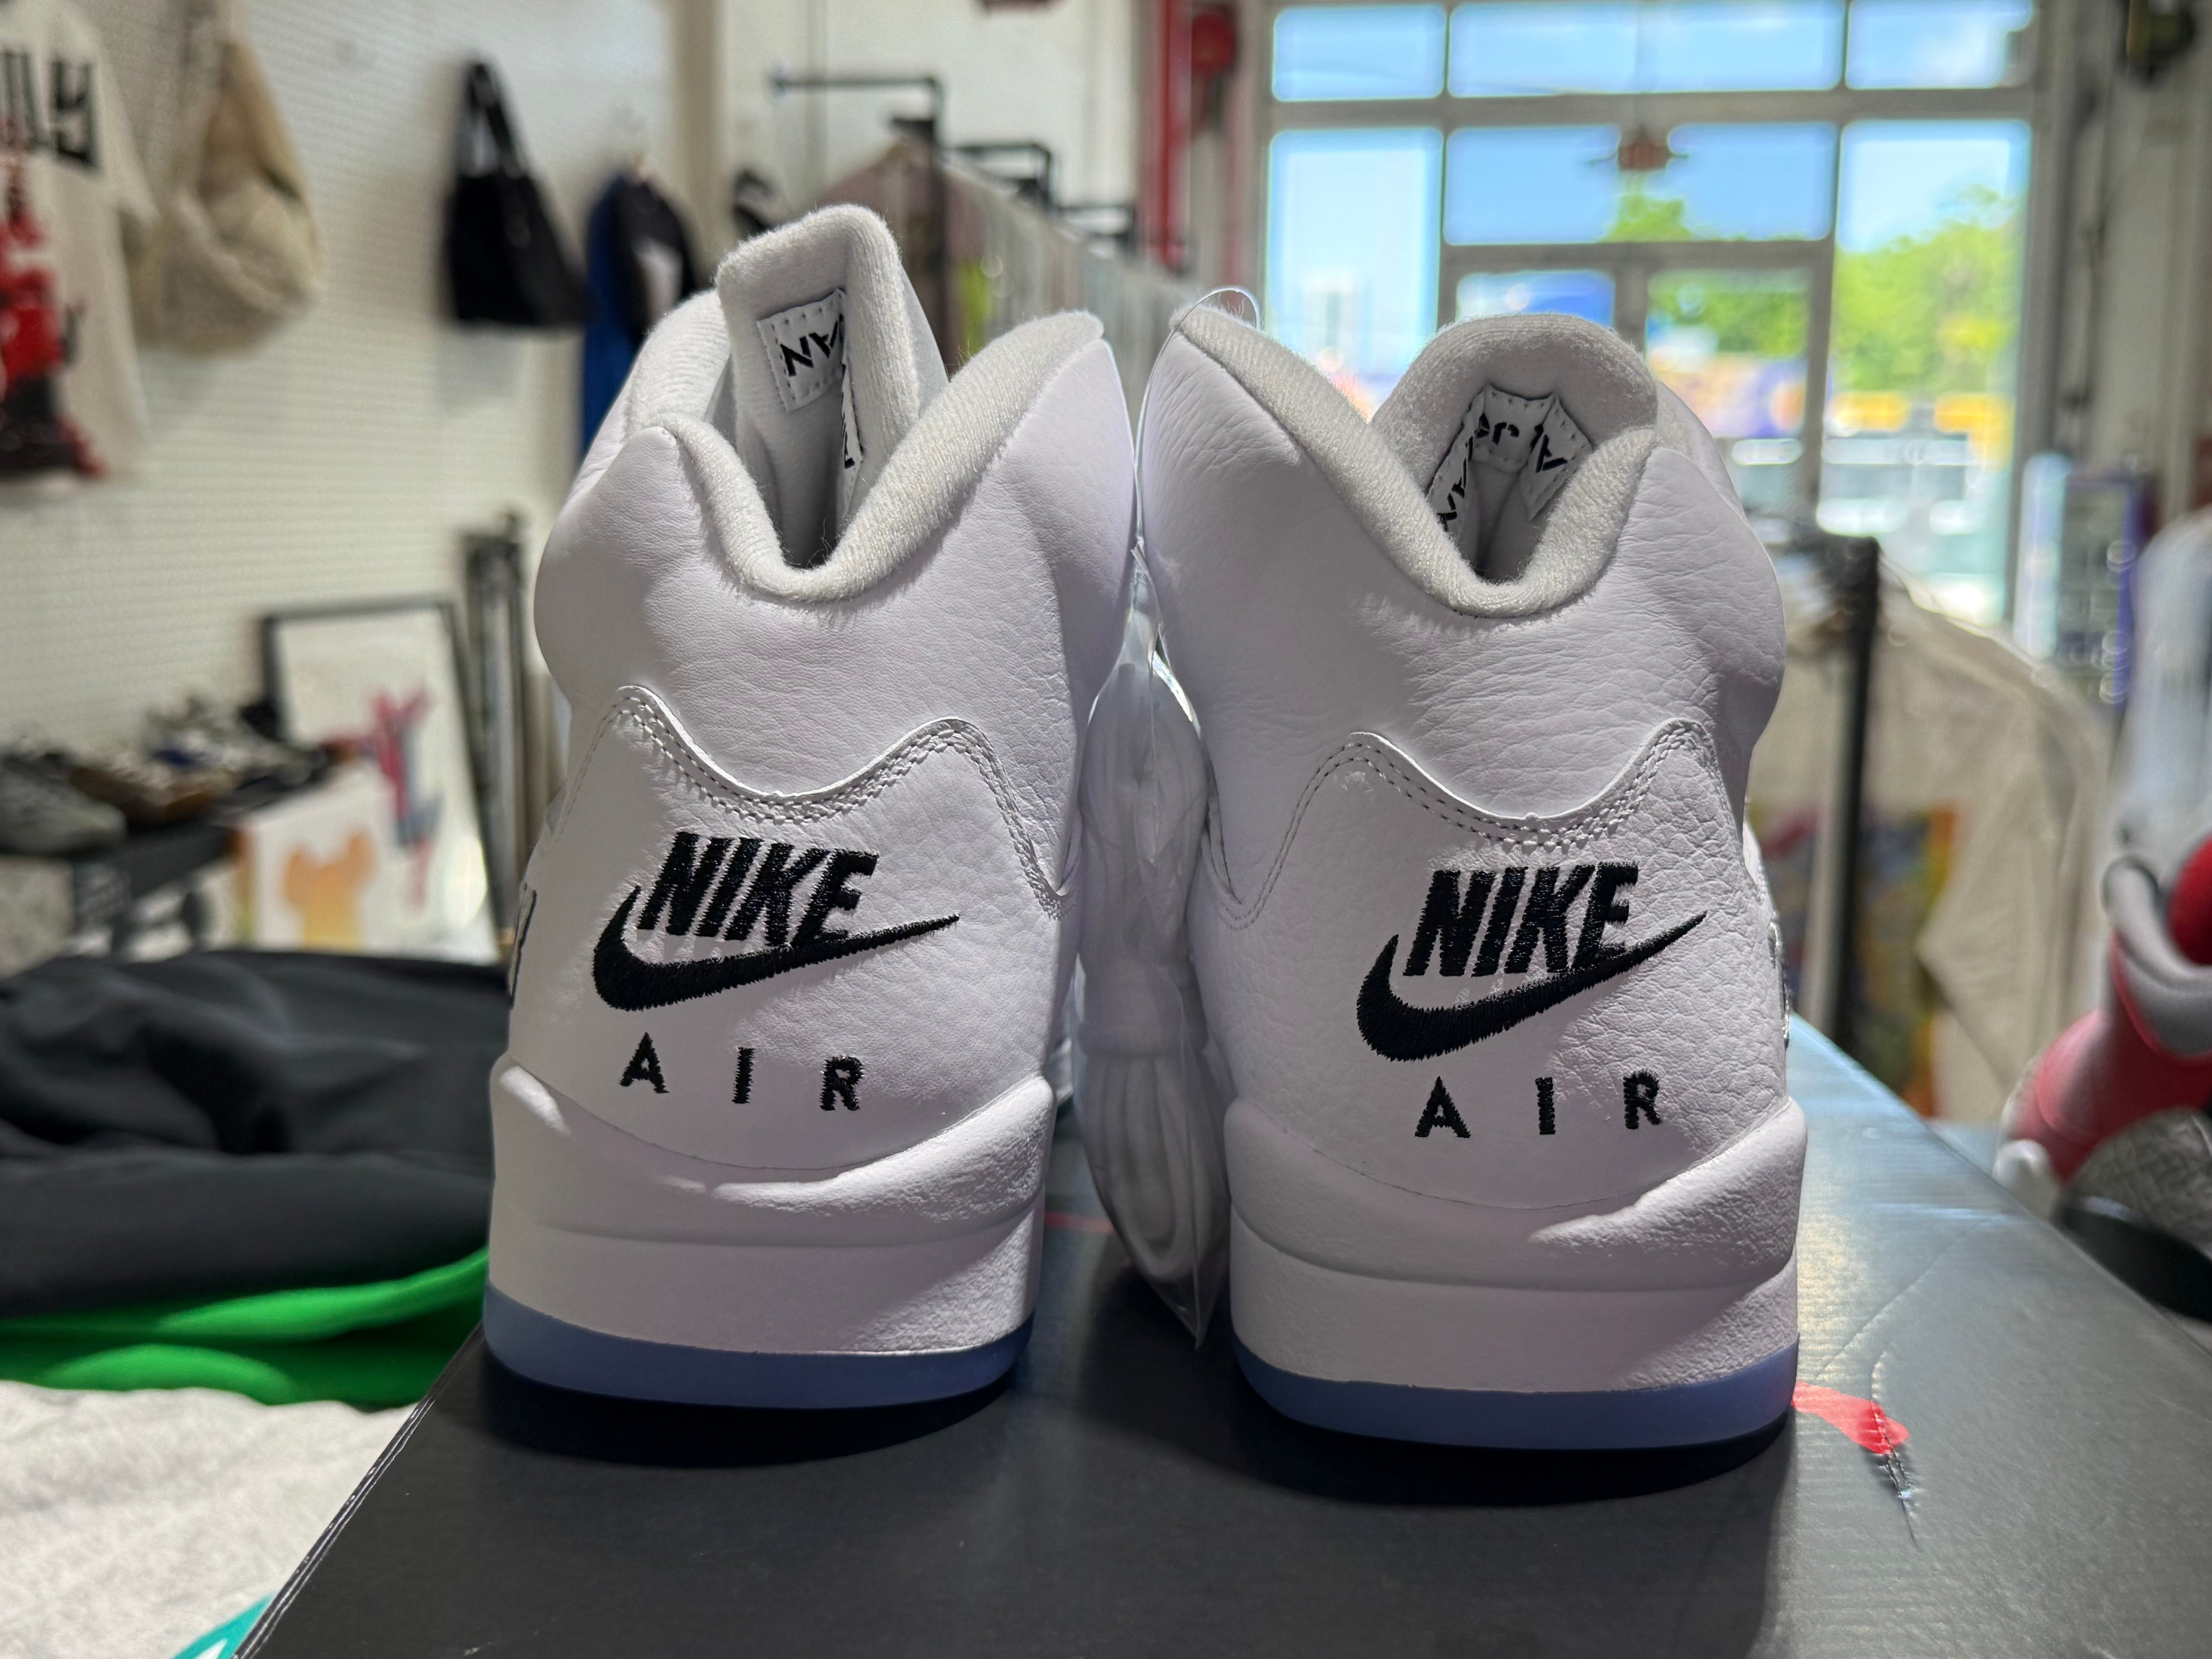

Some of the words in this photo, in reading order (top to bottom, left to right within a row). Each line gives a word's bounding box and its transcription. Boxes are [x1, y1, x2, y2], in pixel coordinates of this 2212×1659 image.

[635, 832, 878, 946] NIKE
[1403, 862, 1638, 977] NIKE
[620, 1032, 864, 1111] AIR
[1415, 1072, 1662, 1138] AIR
